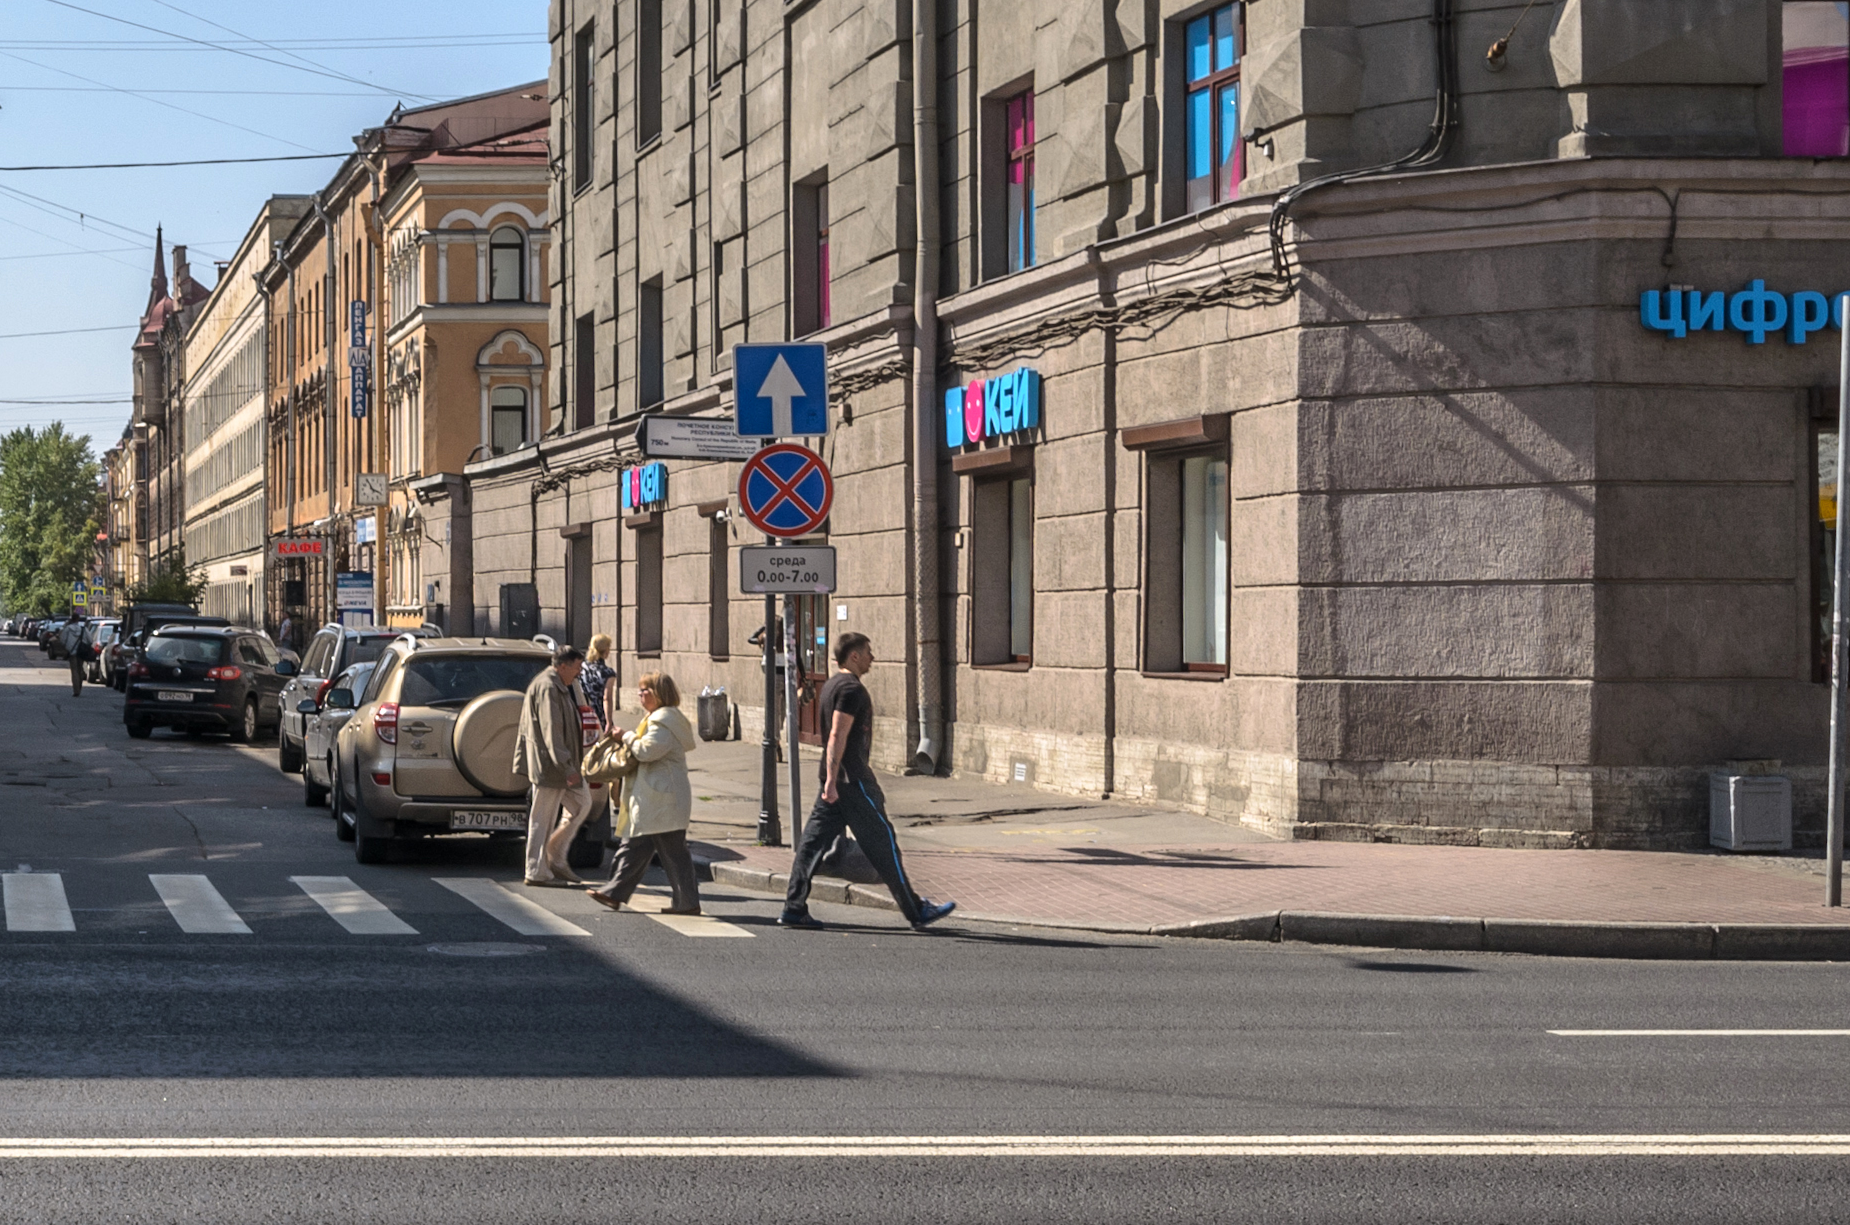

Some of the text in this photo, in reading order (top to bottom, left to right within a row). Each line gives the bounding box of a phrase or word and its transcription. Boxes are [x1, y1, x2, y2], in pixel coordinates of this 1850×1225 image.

[354, 301, 363, 345] ЛЕНГАЗ
[354, 367, 363, 417] АППАРАТ
[278, 541, 322, 554] КАФЕ
[769, 557, 806, 567] среда
[757, 570, 819, 583] 0.00-7.00
